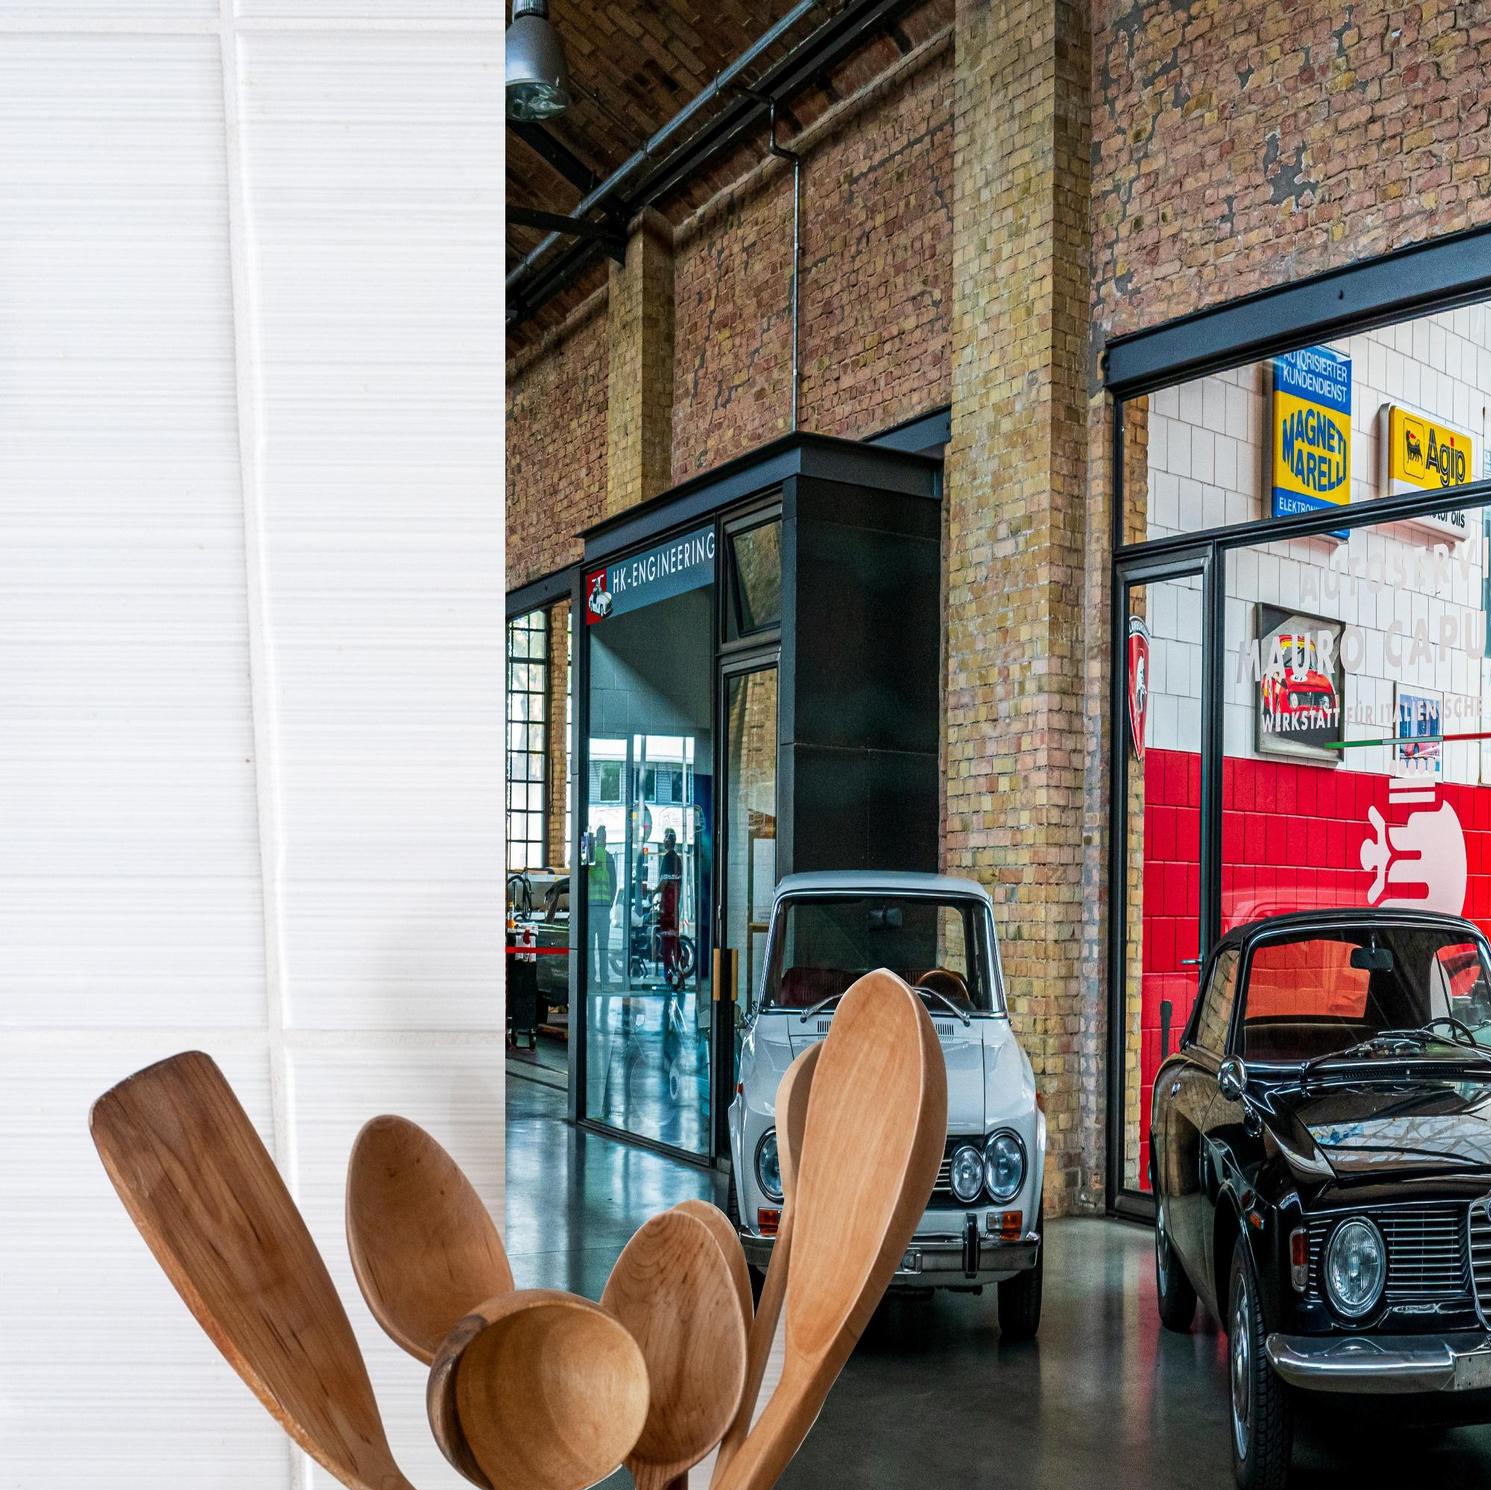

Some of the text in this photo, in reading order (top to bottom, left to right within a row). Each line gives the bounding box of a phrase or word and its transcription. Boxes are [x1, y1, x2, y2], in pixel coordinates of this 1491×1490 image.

[1283, 364, 1347, 403] KUNDENDIENST
[1282, 408, 1347, 460] MAGNETI
[1426, 428, 1466, 487] Agip
[1282, 444, 1347, 493] MARELLI
[1279, 496, 1321, 514] ELEKTRO
[612, 531, 716, 594] HK-ENGINEERING
[1236, 624, 1365, 684] MAURO
[1261, 706, 1341, 734] WERKSTATT
[1346, 702, 1374, 725] FÜR
[1380, 696, 1483, 725] ITALENSCHE
